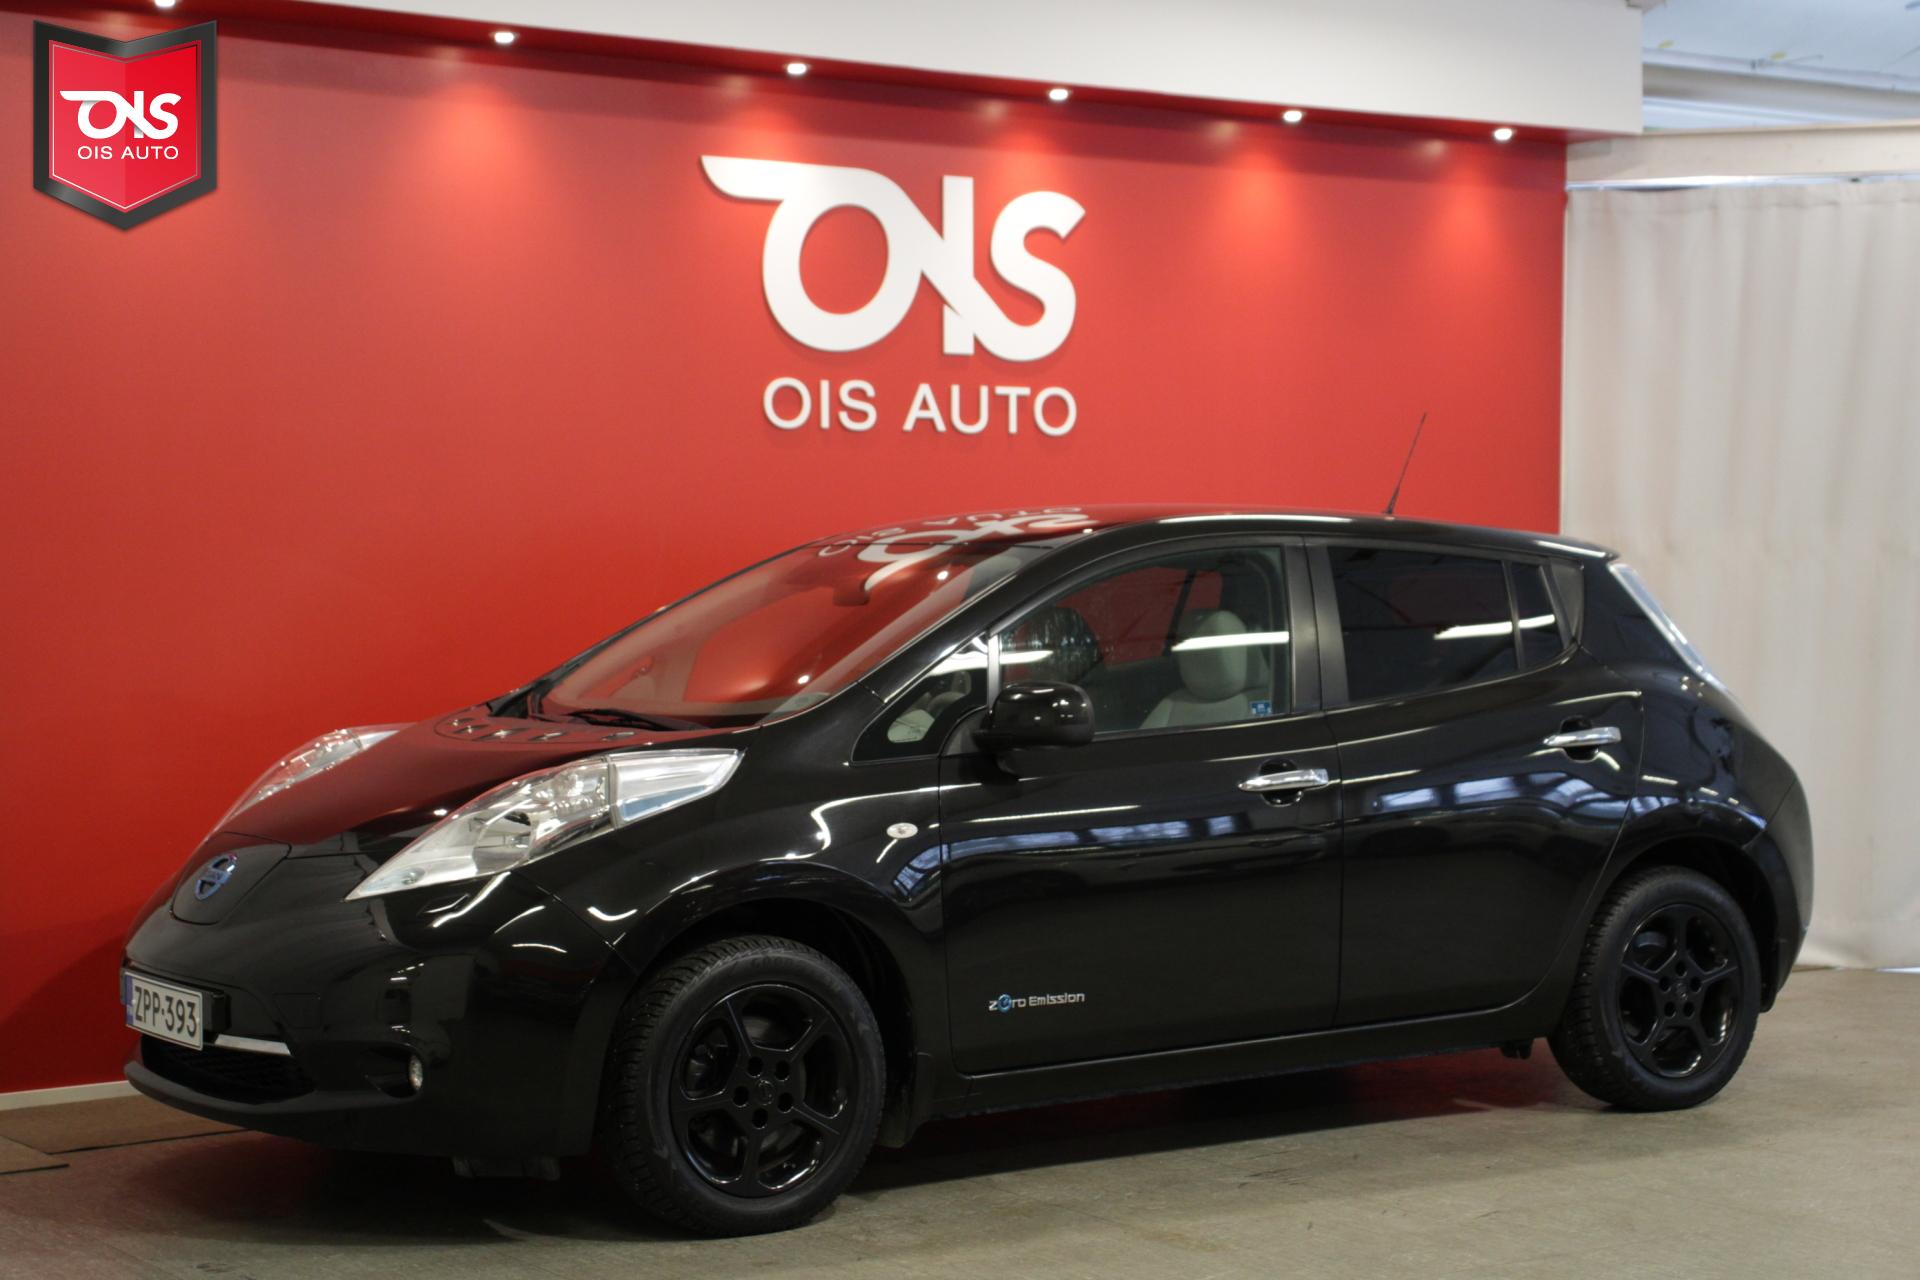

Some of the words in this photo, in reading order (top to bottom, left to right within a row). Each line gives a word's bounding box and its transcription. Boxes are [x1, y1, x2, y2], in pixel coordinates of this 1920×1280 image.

[763, 377, 877, 431] OIS
[903, 384, 1077, 436] AUTO
[135, 986, 197, 1037] ZPP-393
[1029, 993, 1085, 1006] Emission
